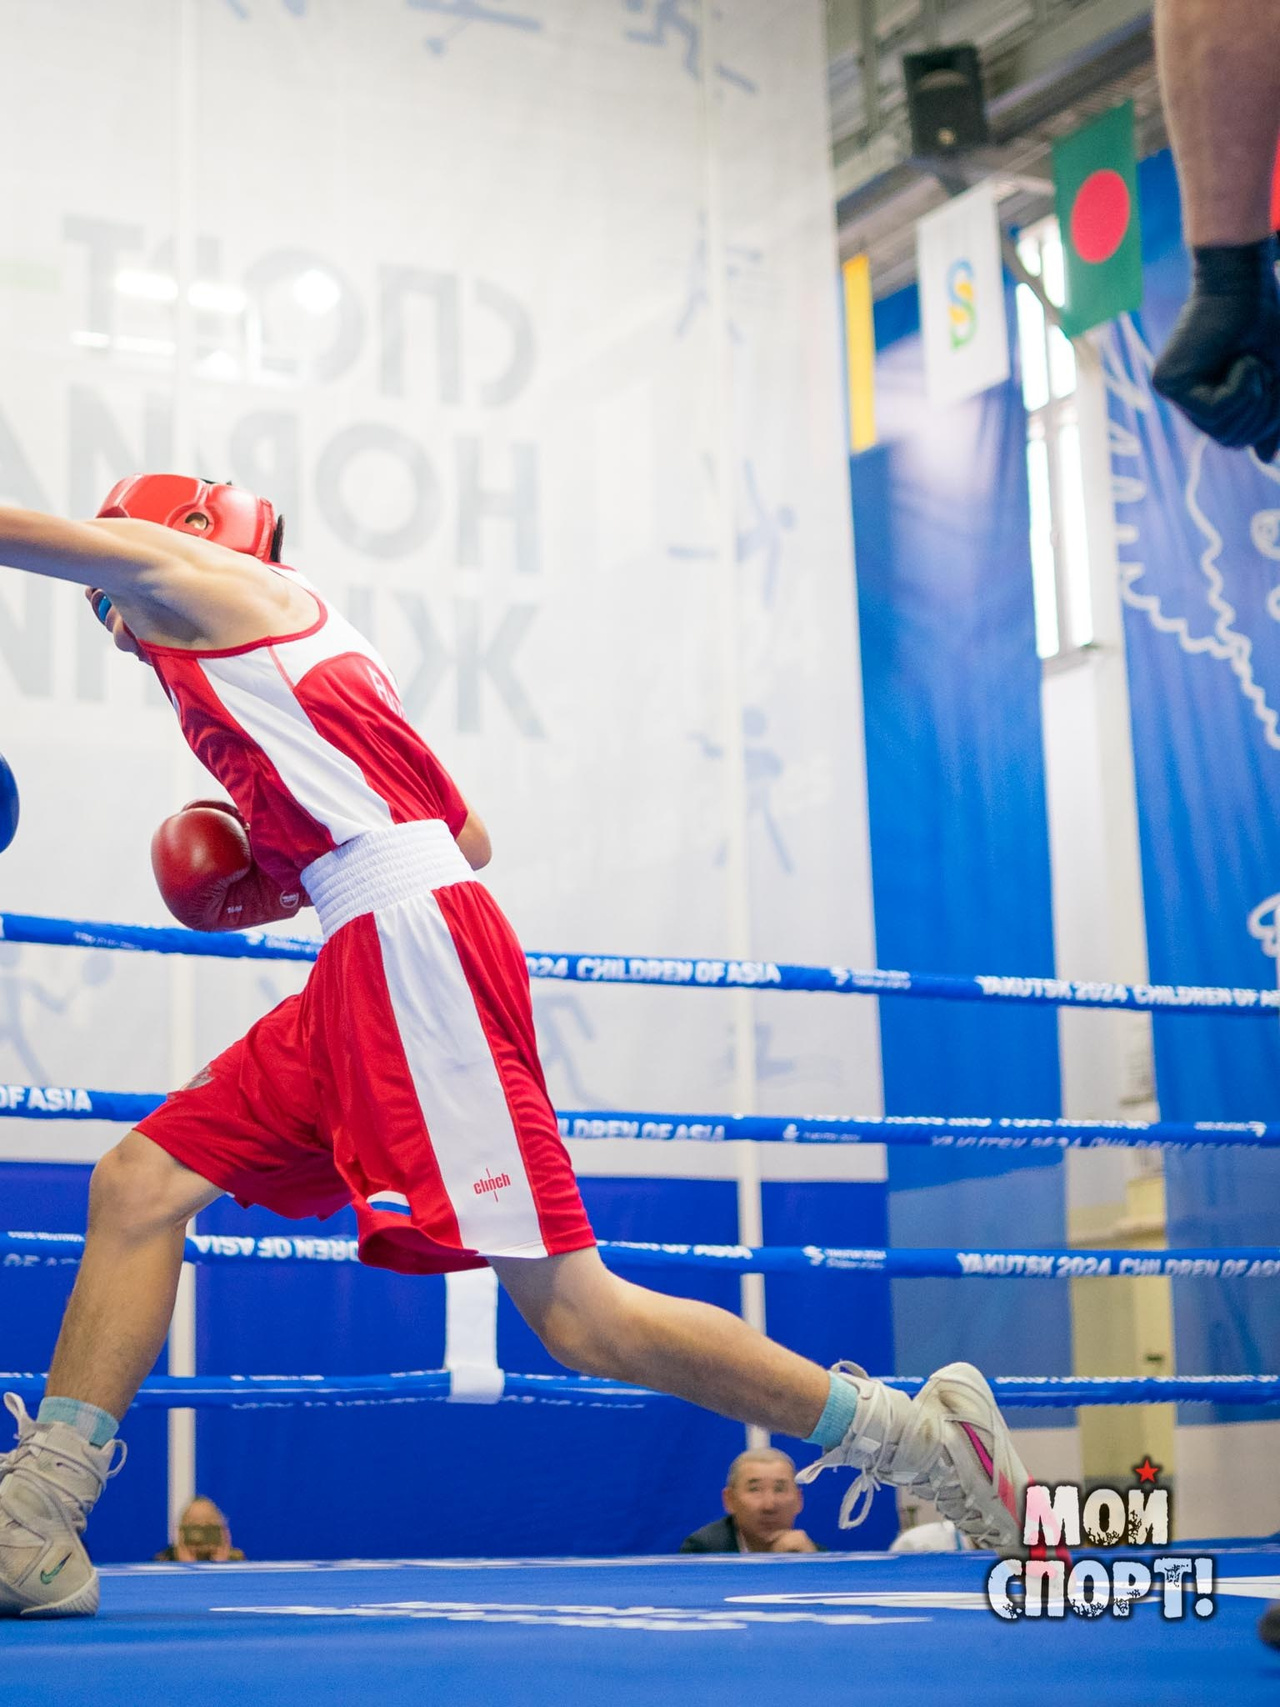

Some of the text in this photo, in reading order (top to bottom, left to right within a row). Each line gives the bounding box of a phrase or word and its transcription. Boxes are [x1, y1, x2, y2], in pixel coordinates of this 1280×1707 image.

[576, 958, 692, 982] CHILDREN
[695, 962, 725, 983] OF
[726, 963, 781, 985] ASIA
[26, 1086, 93, 1113] ASIA
[473, 1172, 511, 1195] clinch
[956, 1252, 1055, 1275] YAKUTSK
[1056, 1256, 1112, 1278] 2024
